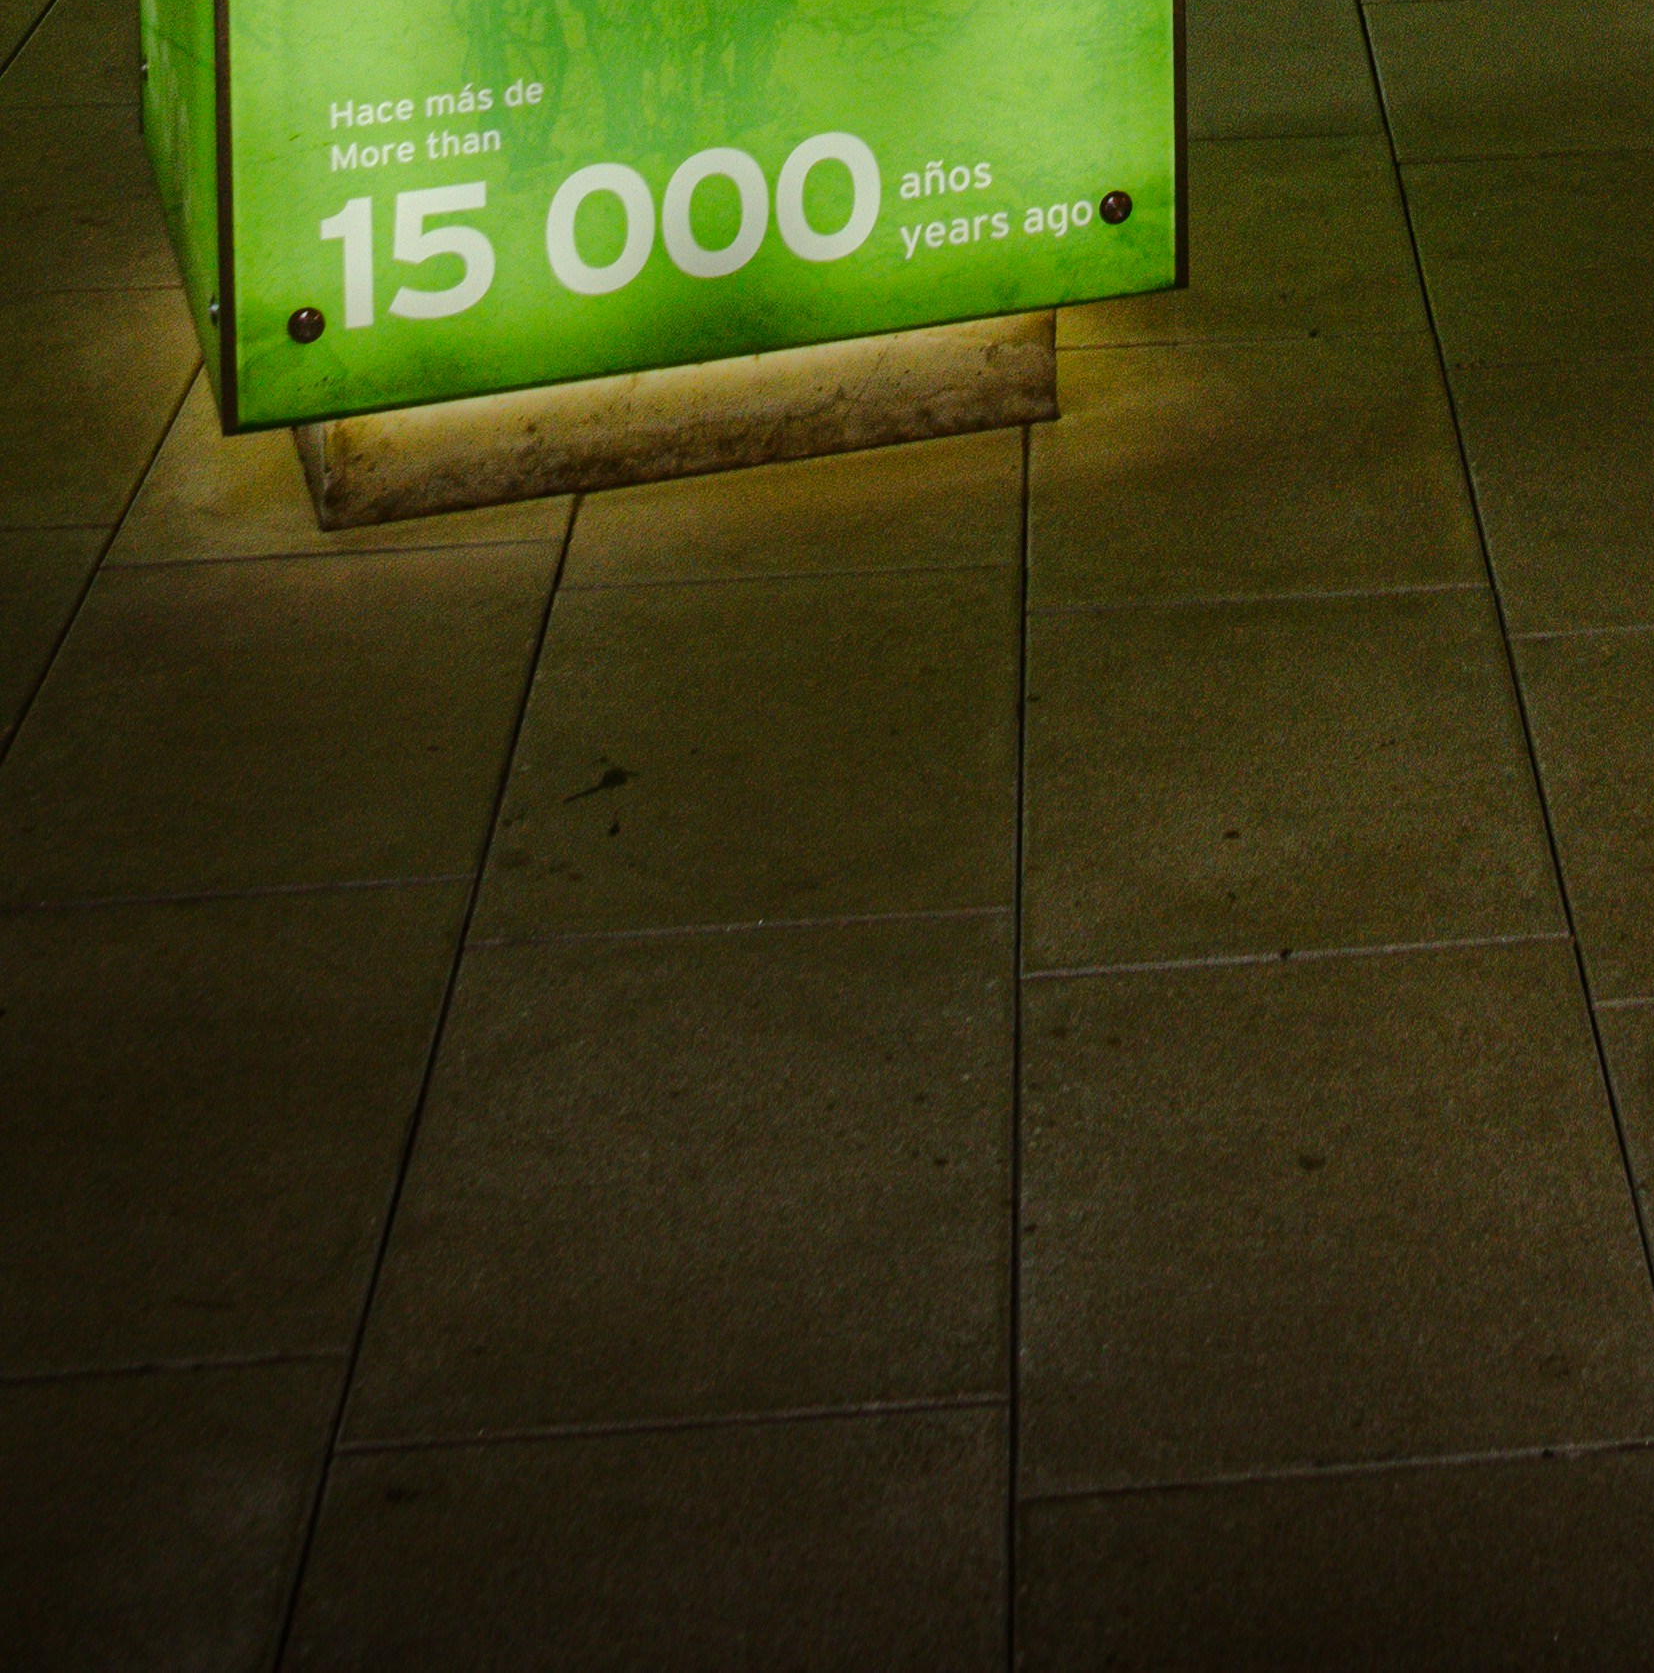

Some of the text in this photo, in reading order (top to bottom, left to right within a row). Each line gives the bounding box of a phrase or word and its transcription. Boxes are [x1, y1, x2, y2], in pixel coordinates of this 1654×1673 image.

[330, 79, 544, 129] Hace más de
[331, 130, 501, 171] More than
[900, 160, 993, 199] años
[319, 131, 882, 329] 15 000
[899, 200, 1093, 259] years ago
